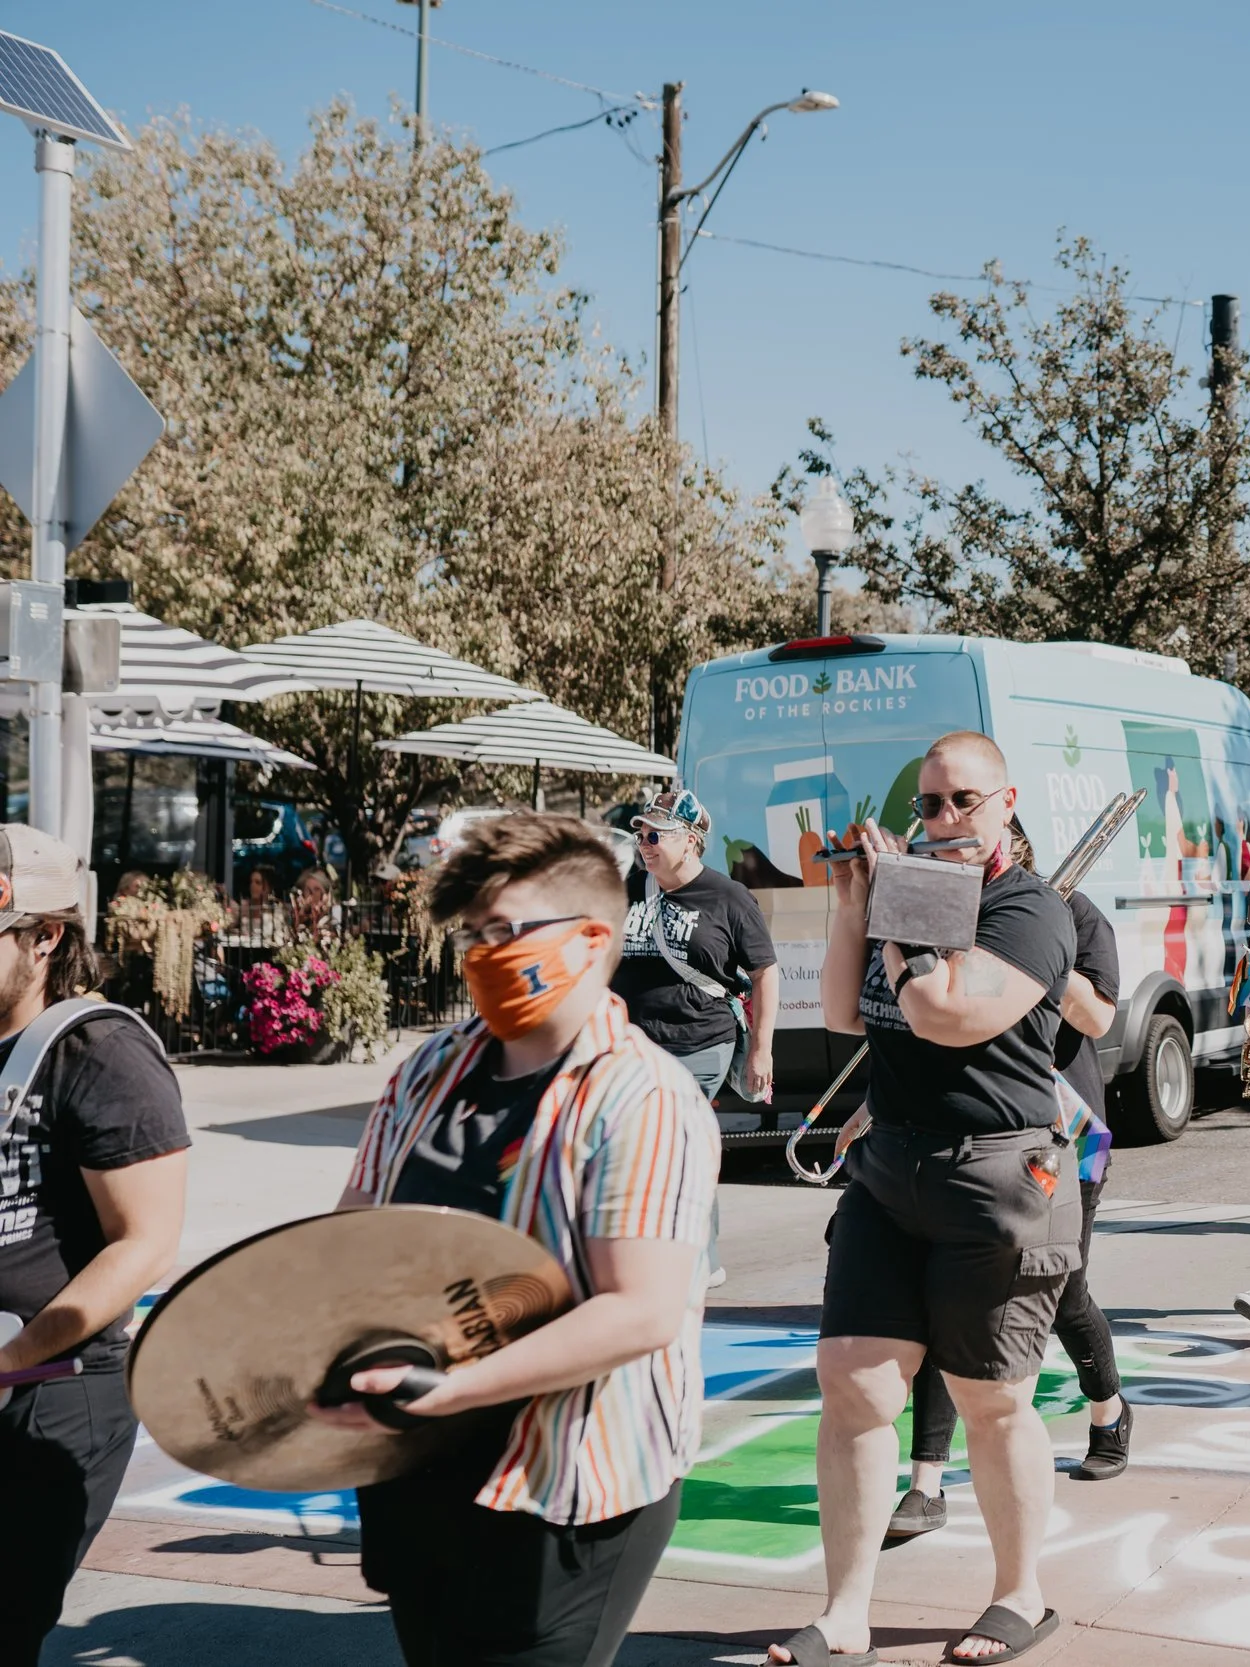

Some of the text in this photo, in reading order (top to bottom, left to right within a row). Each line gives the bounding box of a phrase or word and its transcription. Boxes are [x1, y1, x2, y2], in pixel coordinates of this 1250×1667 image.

[734, 664, 917, 702] FOOD BANK
[744, 696, 907, 721] OF THE ROCKIES
[1045, 773, 1107, 812] FOOD
[780, 965, 822, 982] Volun
[779, 999, 823, 1010] foodban
[442, 1276, 500, 1362] ABIAN
